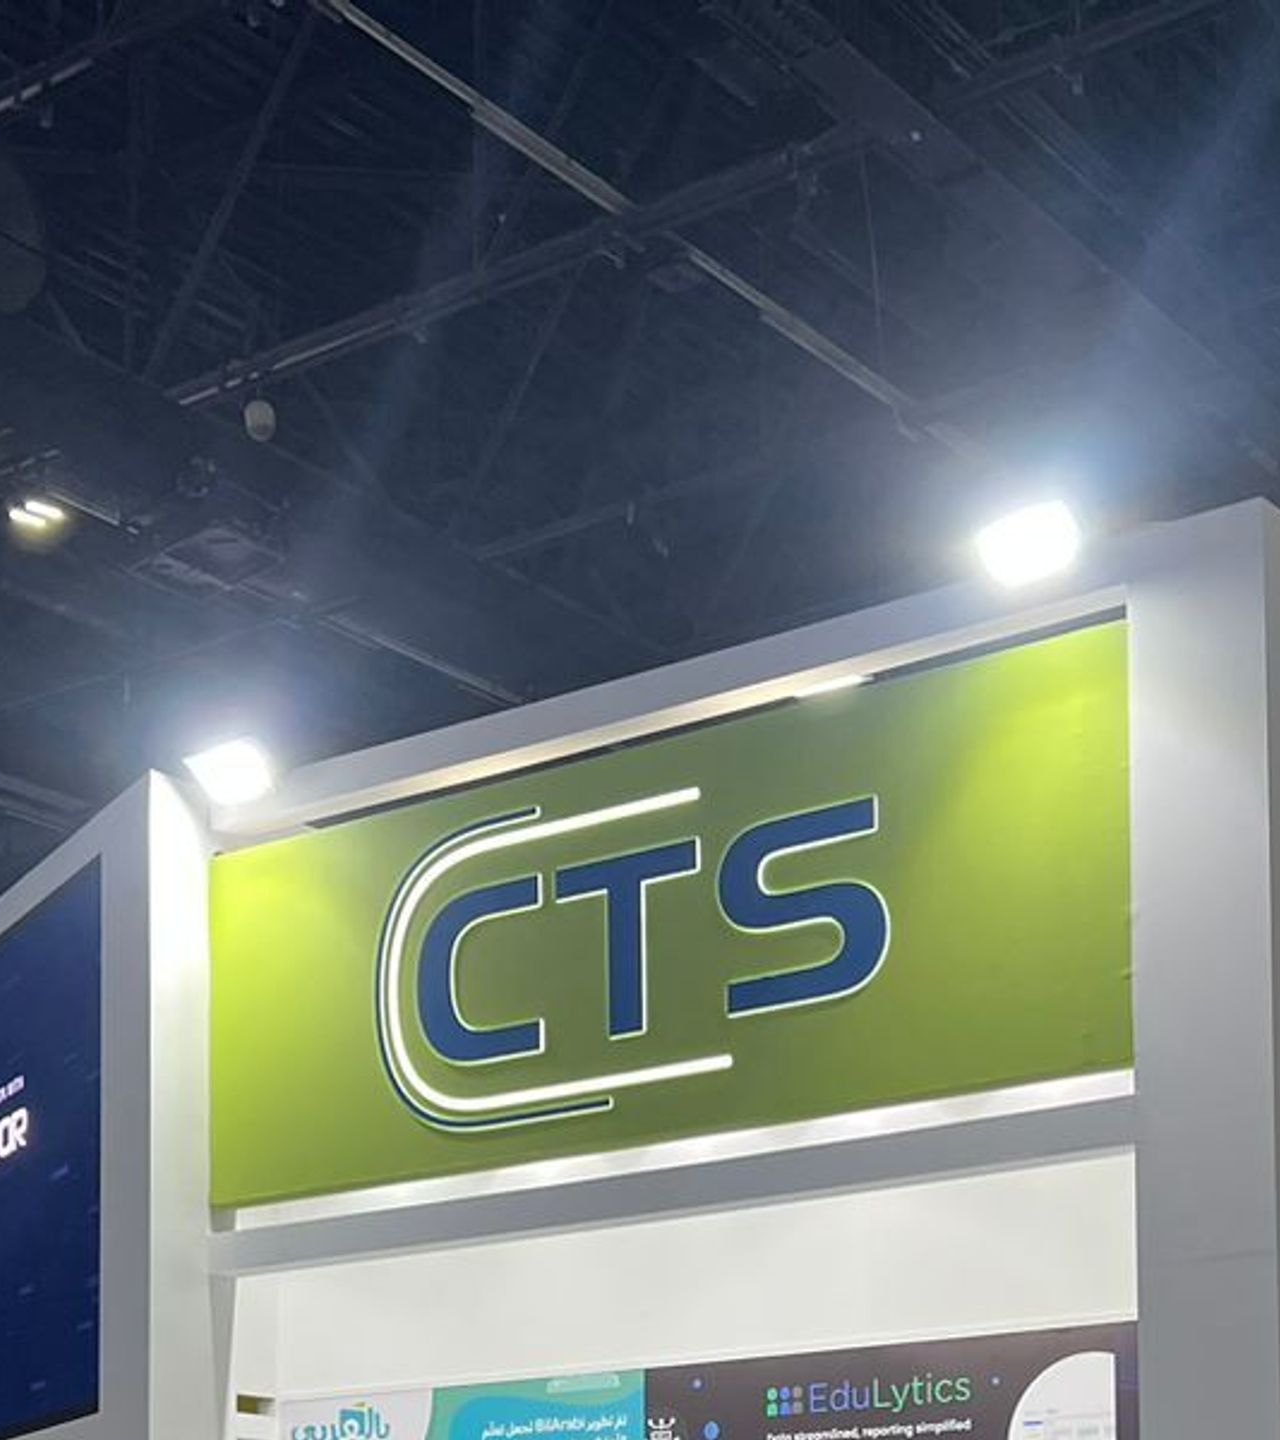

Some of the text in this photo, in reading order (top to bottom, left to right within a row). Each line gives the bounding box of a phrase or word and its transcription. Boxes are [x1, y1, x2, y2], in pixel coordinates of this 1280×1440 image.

[416, 795, 890, 1065] CTS
[809, 1373, 971, 1412] EduLytics
[862, 1423, 913, 1438] reporting
[916, 1419, 972, 1435] simplified
